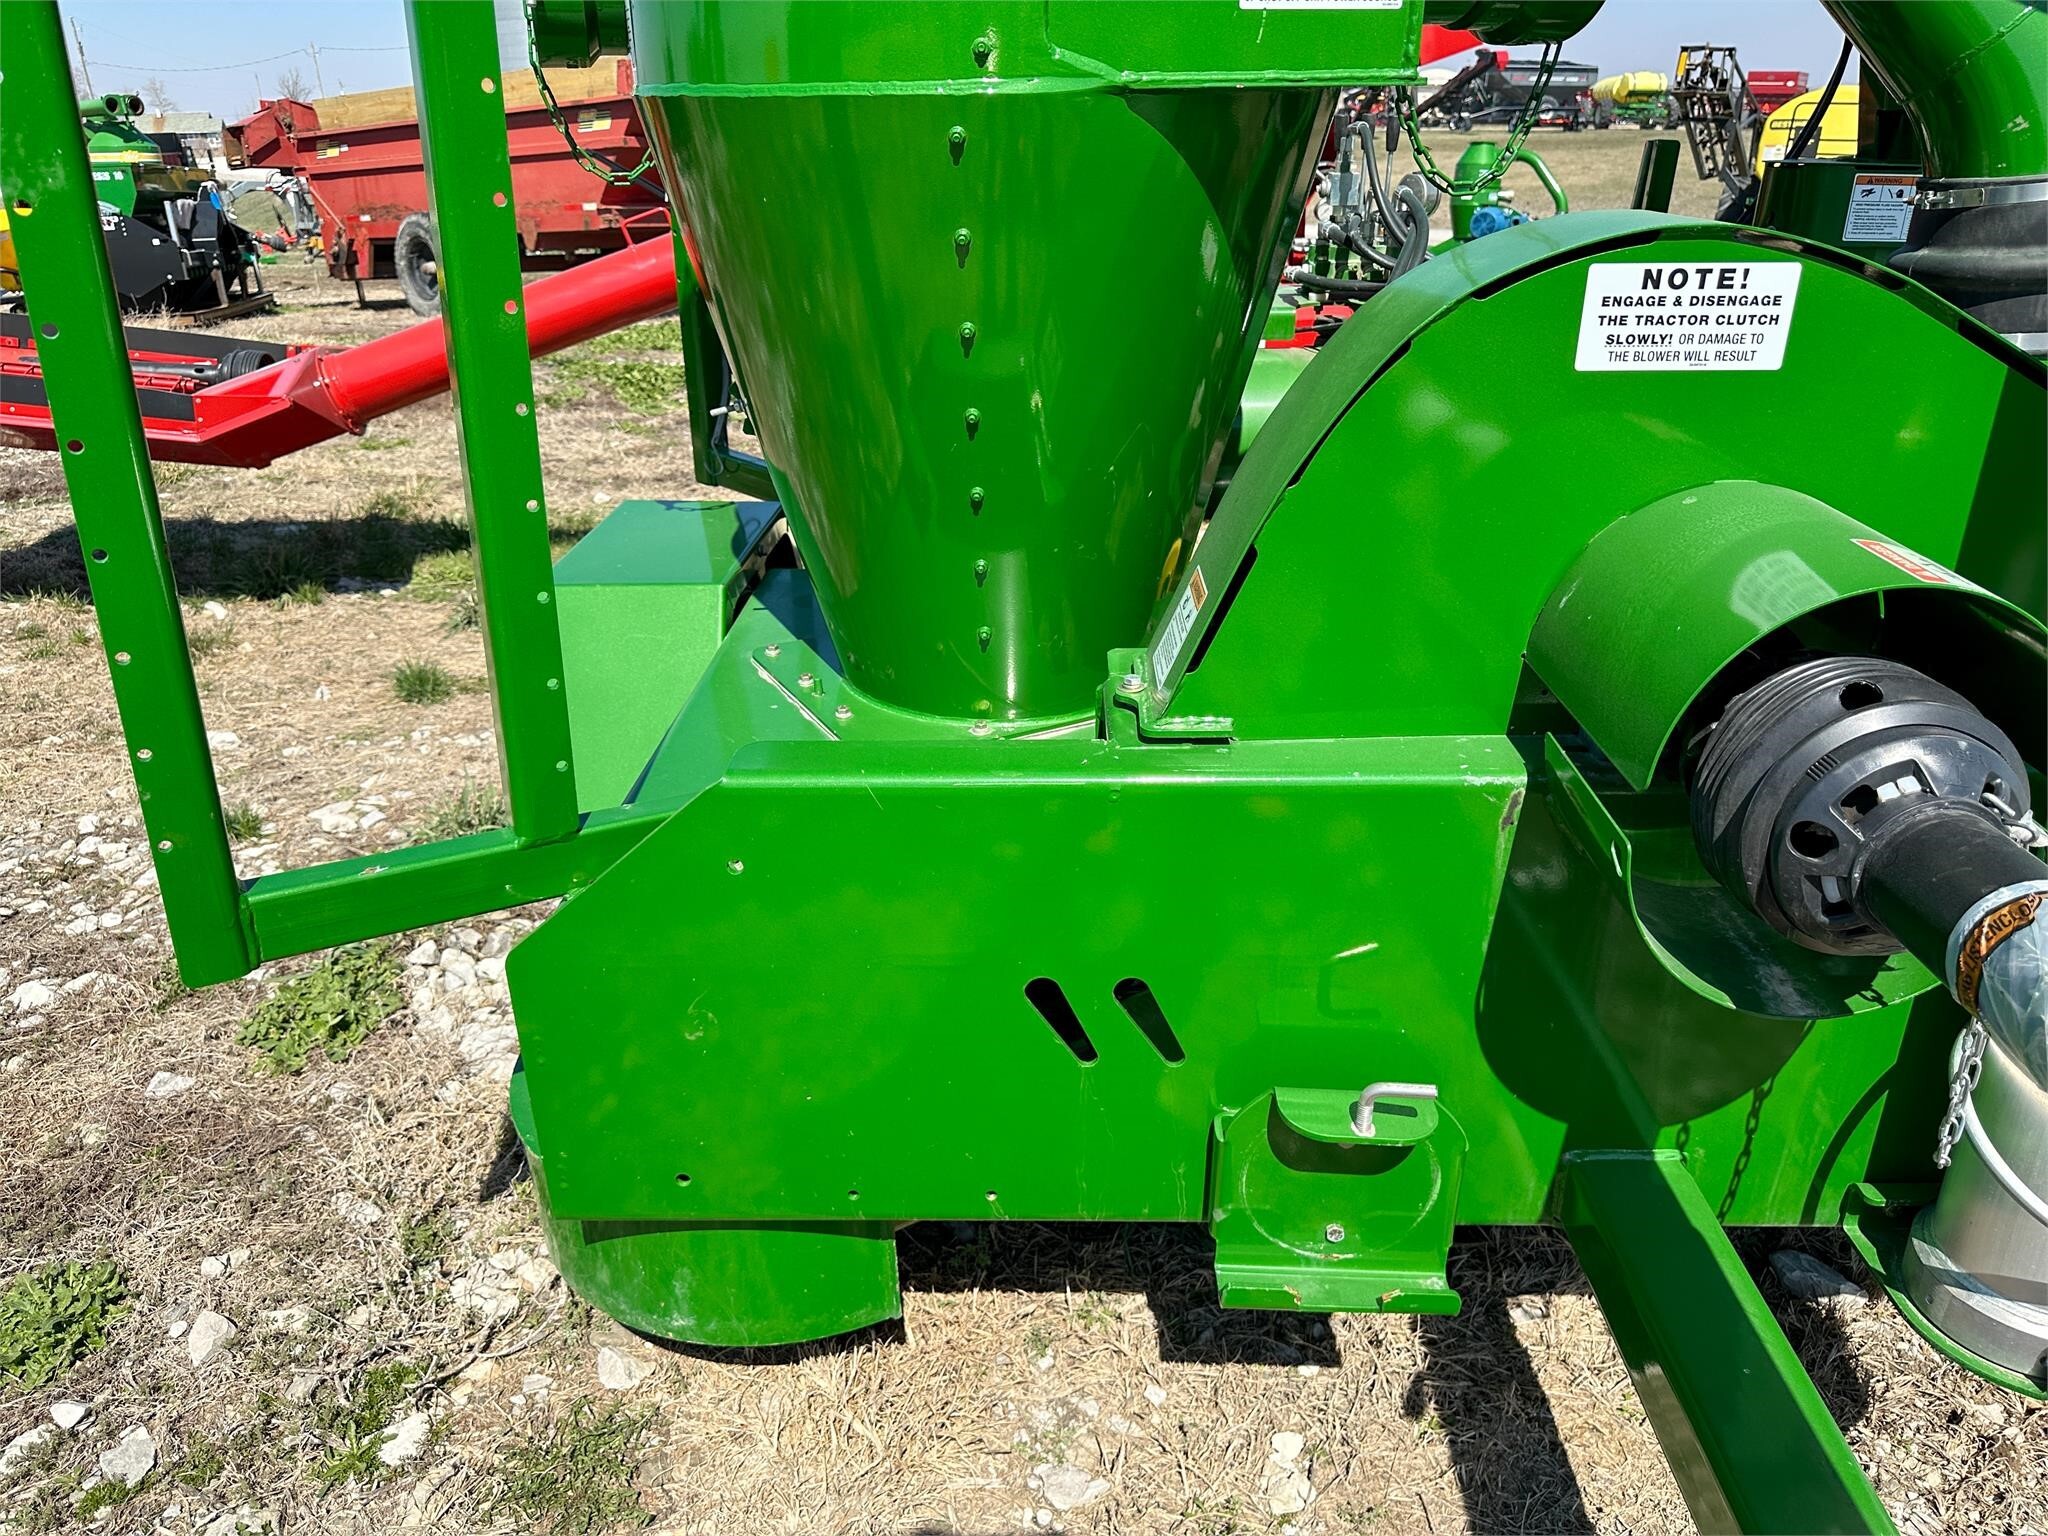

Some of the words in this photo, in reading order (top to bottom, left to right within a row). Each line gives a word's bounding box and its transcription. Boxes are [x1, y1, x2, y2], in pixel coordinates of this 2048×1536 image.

[1641, 268, 1750, 290] NOTE!
[1601, 296, 1667, 307] ENGAGE
[1672, 295, 1683, 307] &
[1689, 295, 1783, 307] DISENGAGE
[1598, 315, 1629, 326] THE
[1635, 315, 1710, 326] TRACTOR
[1715, 314, 1780, 326] CLUTCH
[1605, 334, 1673, 345] SLOWLY!
[1678, 333, 1694, 345] OR
[1698, 333, 1747, 345] DAMAGE
[1750, 333, 1764, 344] TO
[1608, 351, 1629, 362] THE
[1632, 351, 1680, 362] BLOWER
[1684, 351, 1710, 362] WILL
[1714, 350, 1757, 362] RESULT
